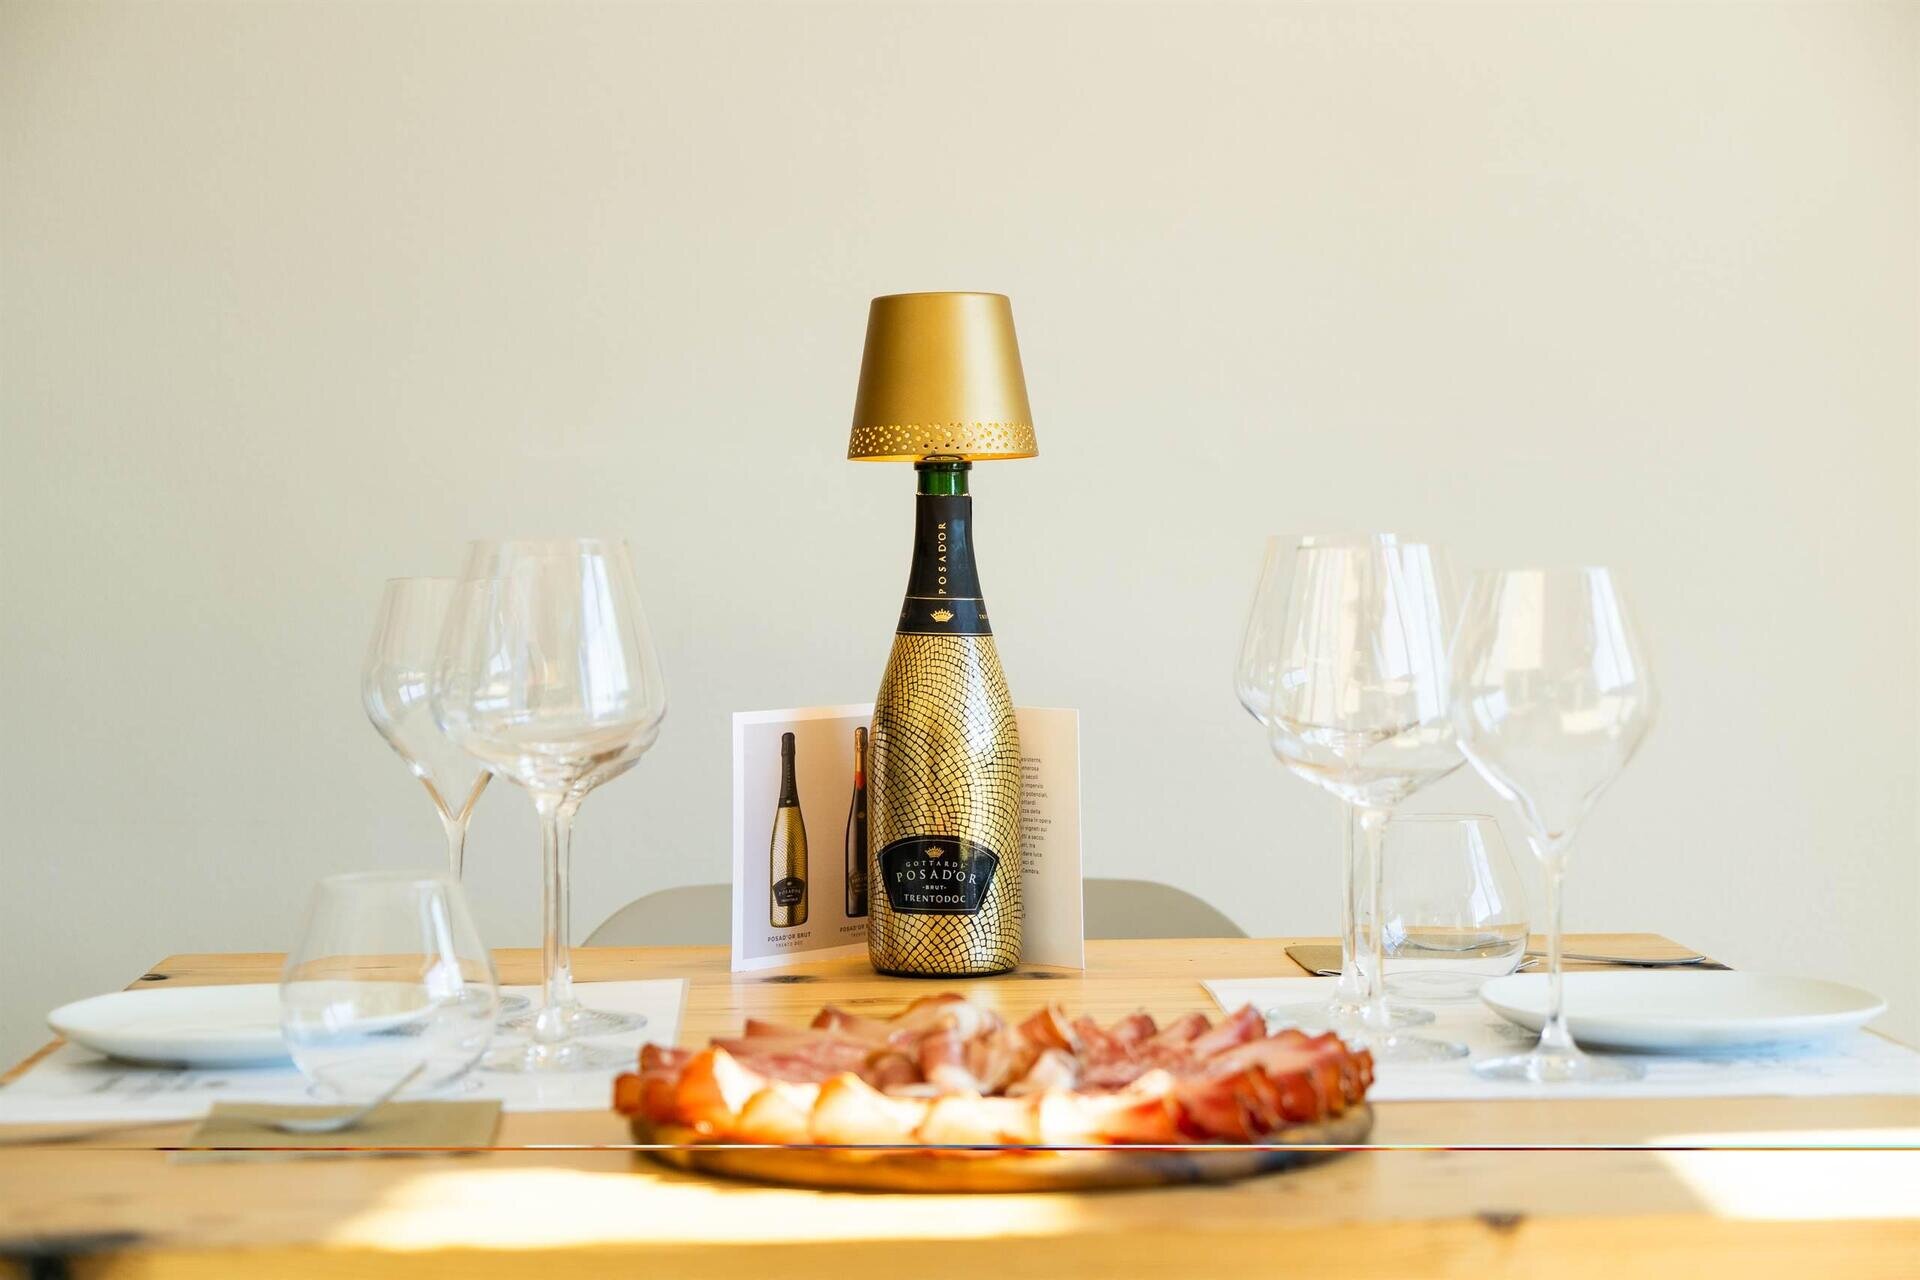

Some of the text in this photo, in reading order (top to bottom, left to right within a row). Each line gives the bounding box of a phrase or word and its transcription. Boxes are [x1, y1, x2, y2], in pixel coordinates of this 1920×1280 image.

[938, 522, 947, 595] POSAD'OR
[896, 869, 977, 885] POSAD'OR
[904, 893, 966, 904] TRENTODOC
